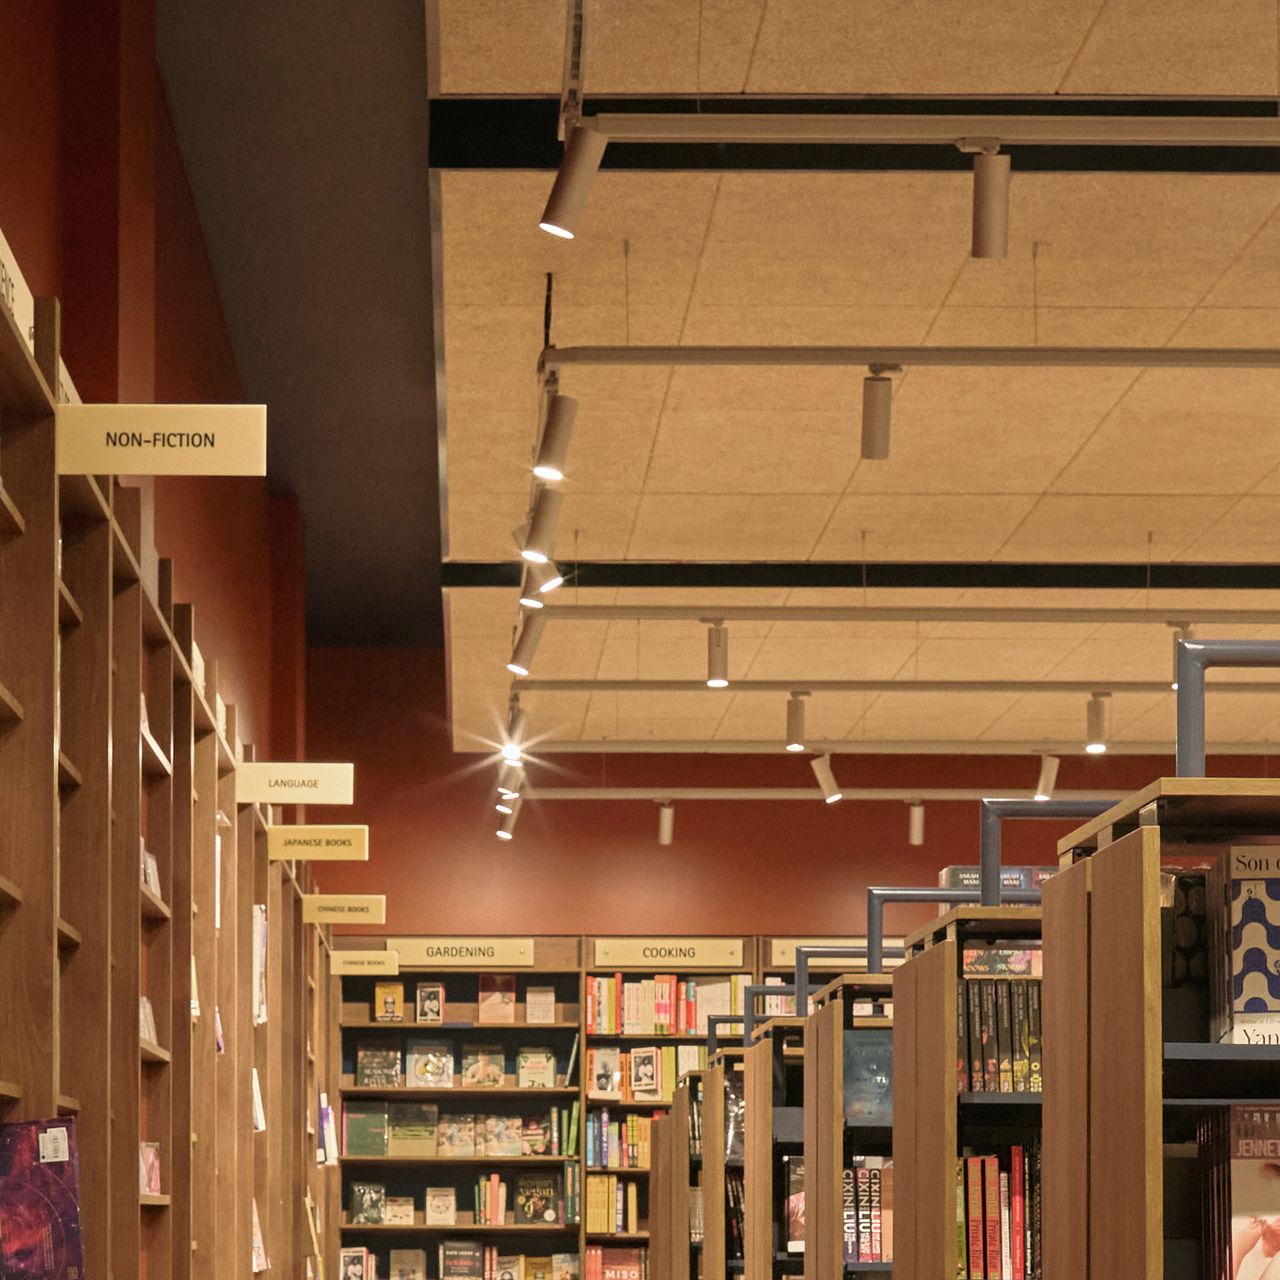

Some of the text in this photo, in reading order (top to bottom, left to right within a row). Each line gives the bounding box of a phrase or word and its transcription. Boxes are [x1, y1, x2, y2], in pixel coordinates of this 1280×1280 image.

[106, 431, 215, 448] NON-FICTION
[268, 779, 320, 789] LANGUAGE
[283, 838, 353, 847] JAPANESE BOOKS
[1234, 853, 1265, 872] Son
[317, 905, 370, 913] CHINESE BOOKS
[425, 945, 495, 958] GARDENING
[642, 946, 696, 959] COOKING
[843, 1169, 856, 1233] CIXIN LIU
[858, 1169, 871, 1233] CIXIN LIU
[604, 1269, 638, 1280] MISO
